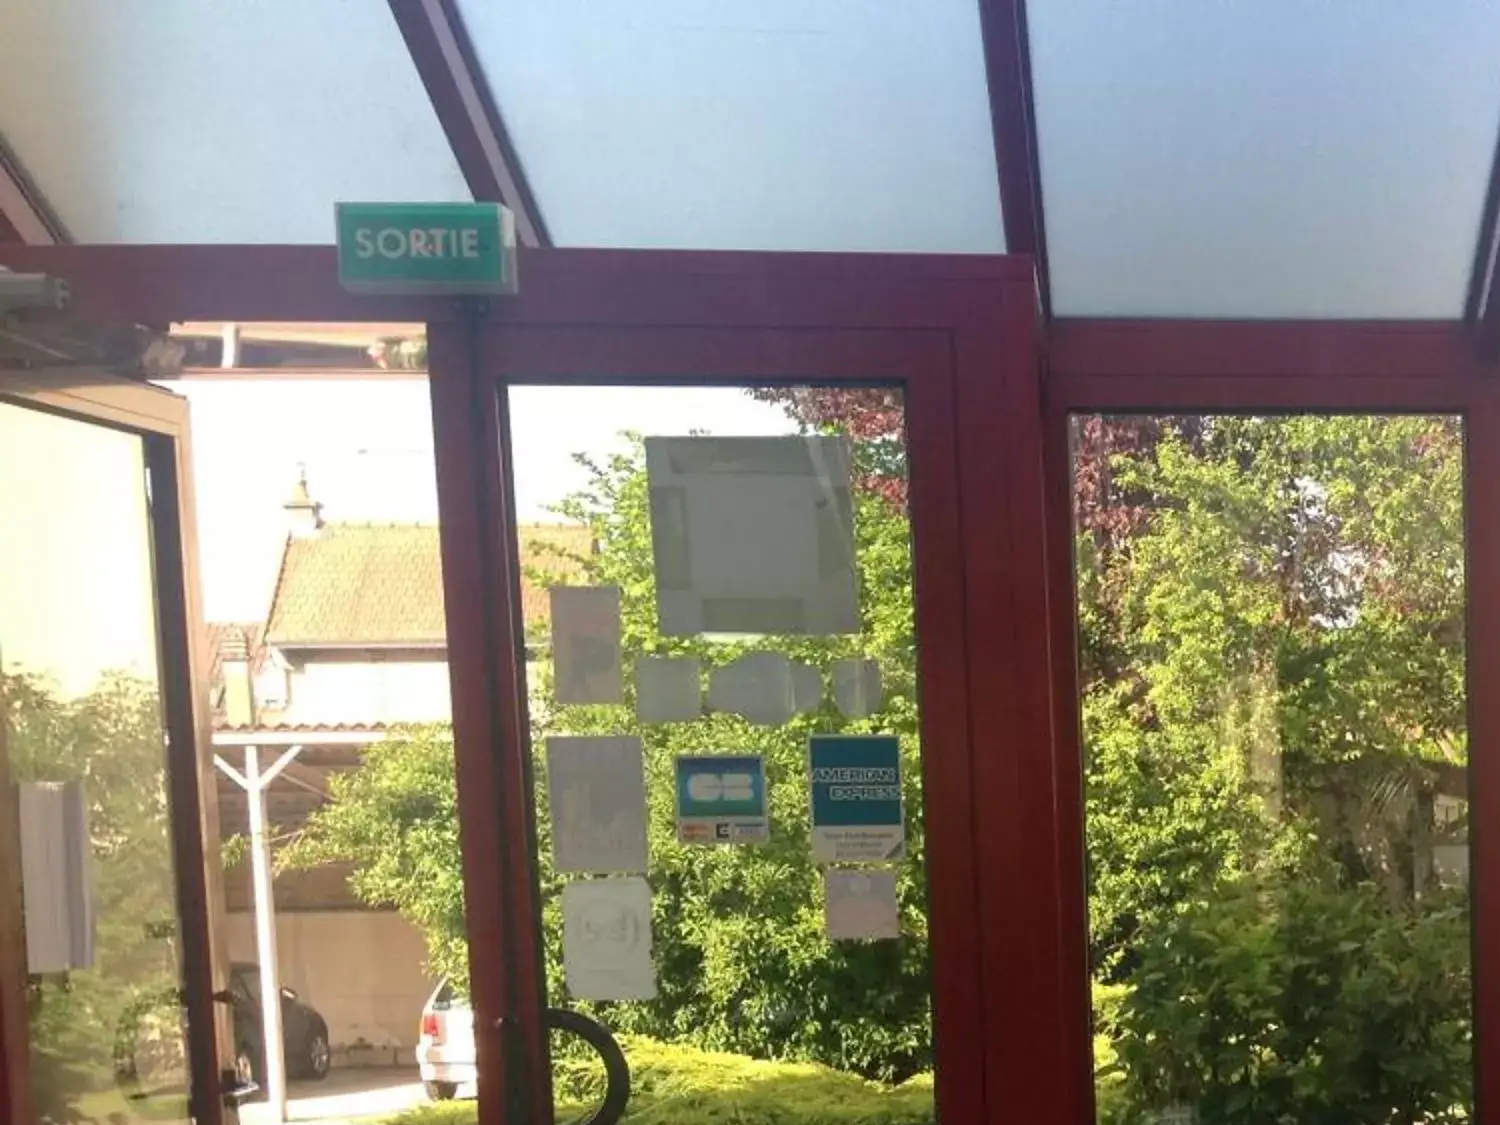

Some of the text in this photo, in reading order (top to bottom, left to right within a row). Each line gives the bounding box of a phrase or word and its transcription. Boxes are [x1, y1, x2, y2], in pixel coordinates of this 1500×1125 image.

[355, 228, 481, 259] SORTIE
[812, 767, 897, 783] AMERICAN
[829, 785, 900, 801] EXPRESS
